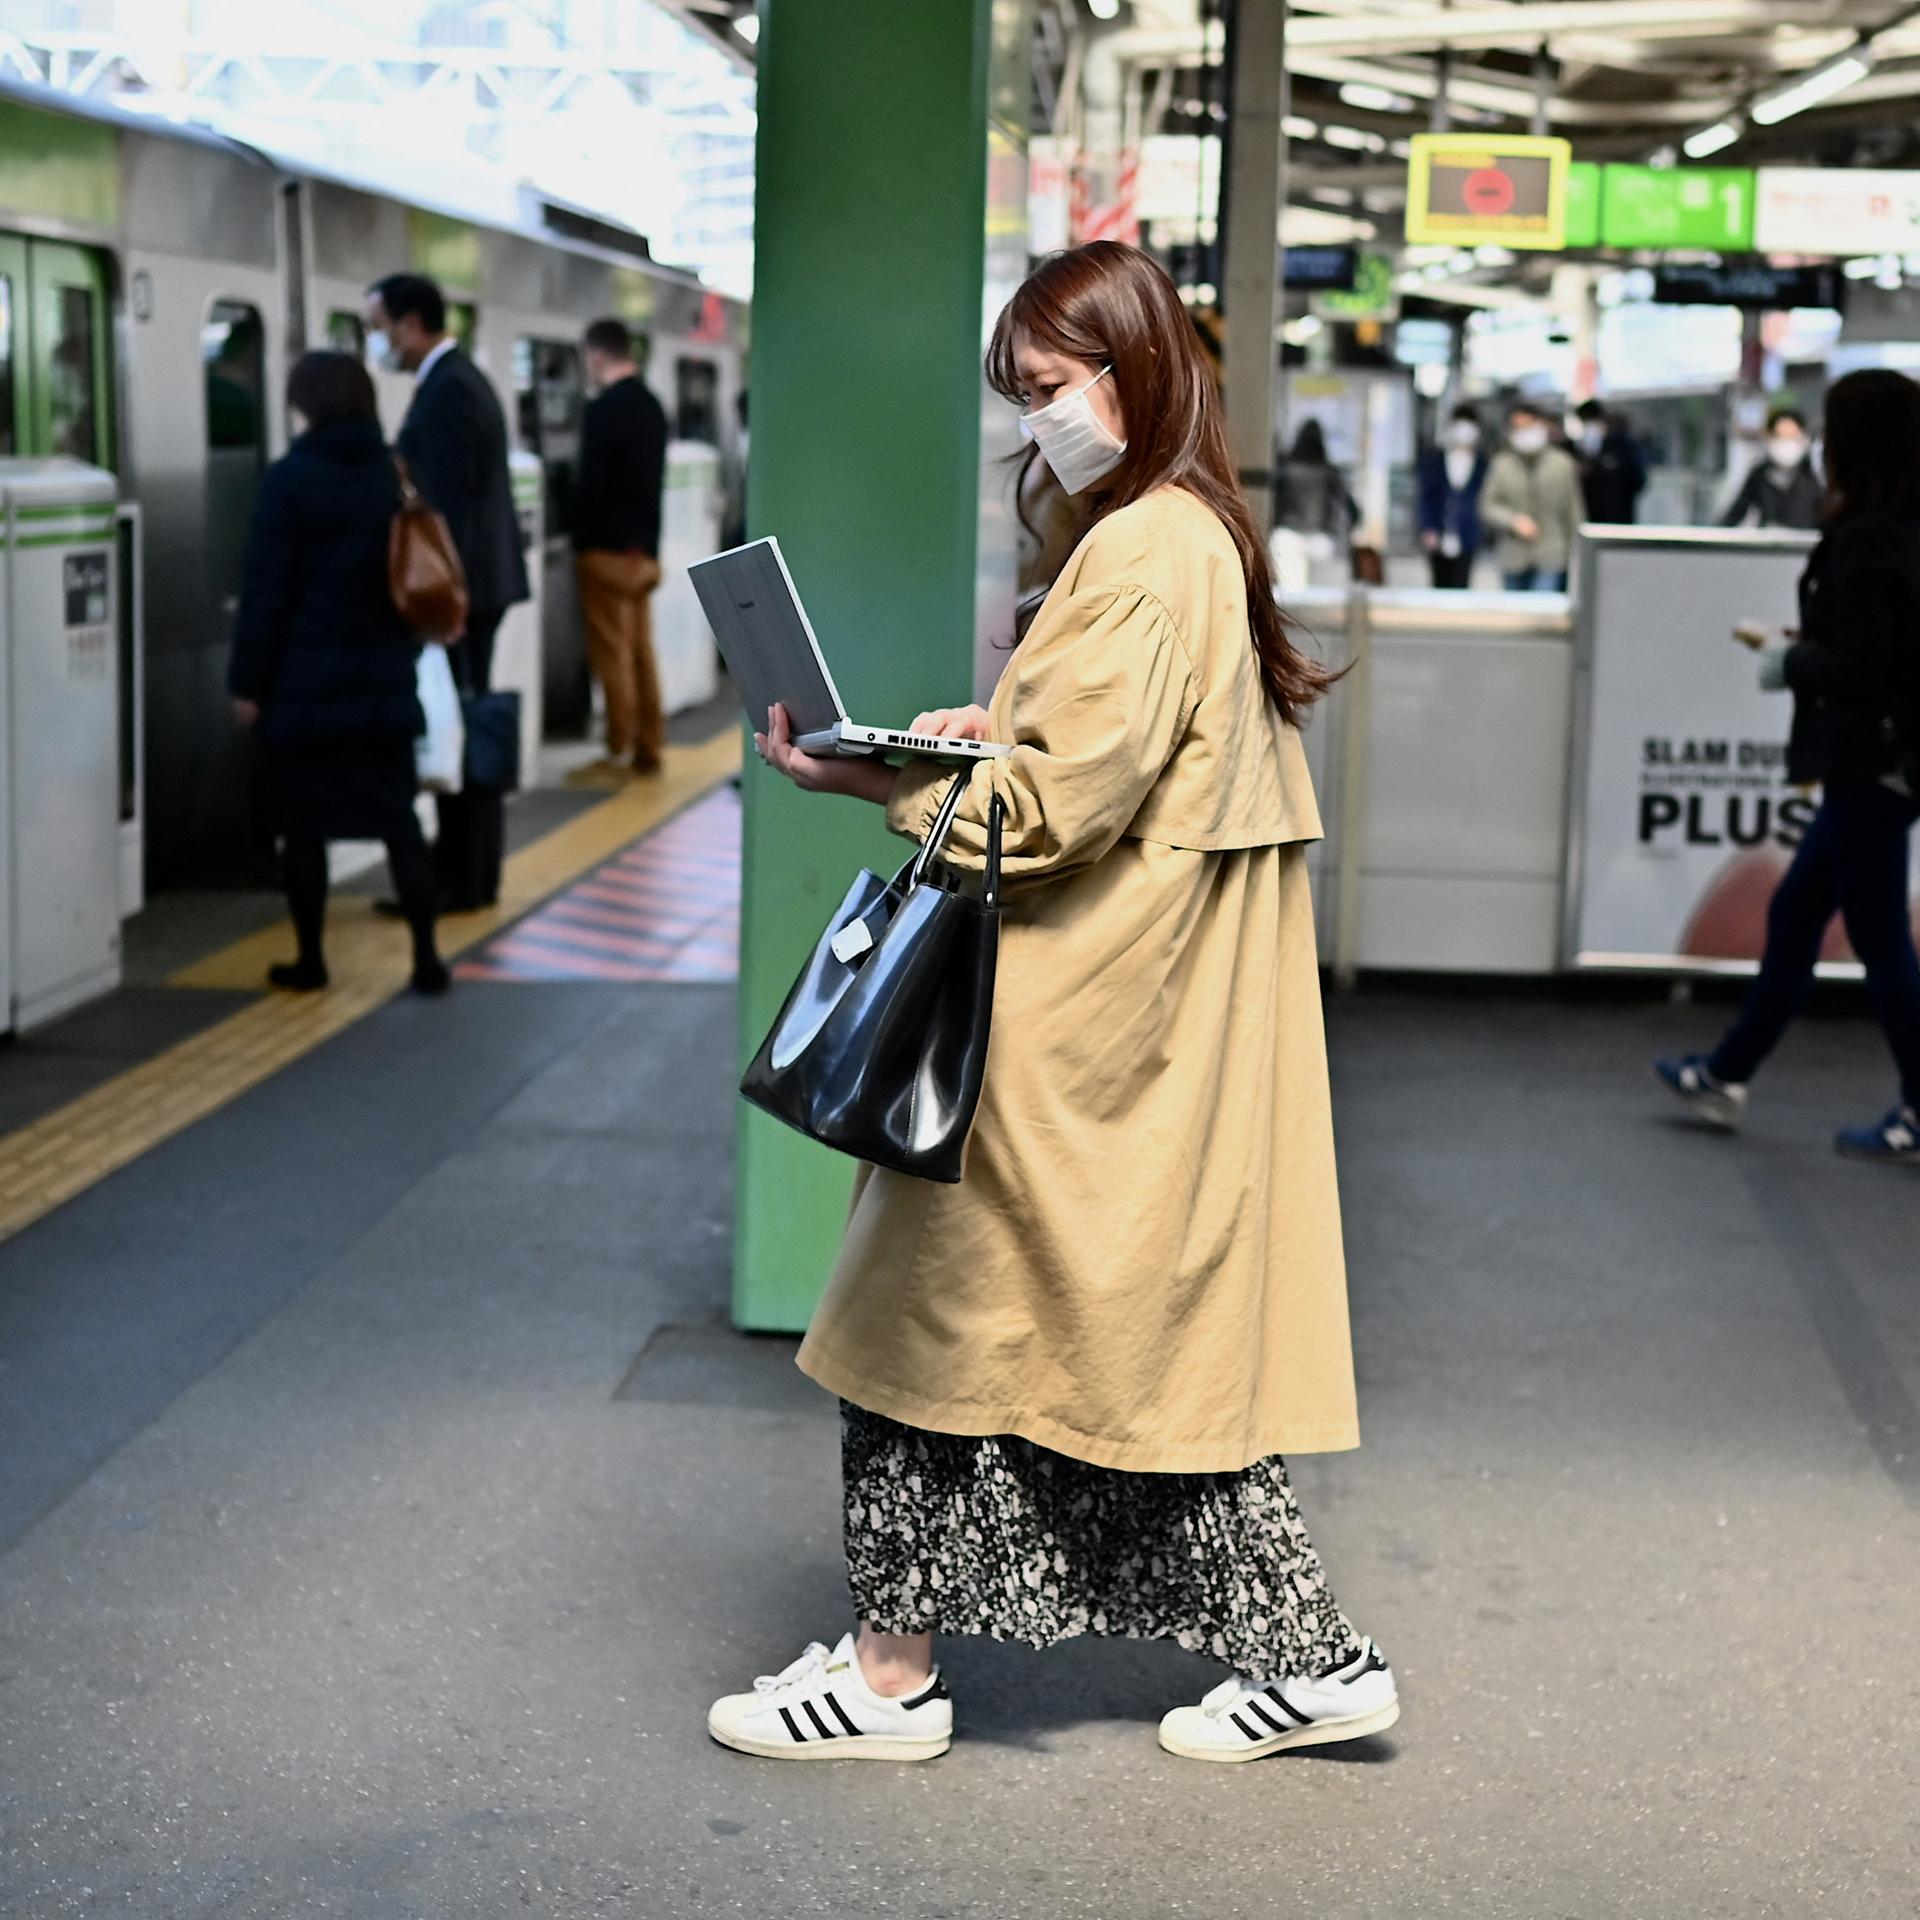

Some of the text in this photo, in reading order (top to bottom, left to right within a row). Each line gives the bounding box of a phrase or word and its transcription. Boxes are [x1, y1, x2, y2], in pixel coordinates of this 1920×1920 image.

[1719, 181, 1742, 236] 1
[1644, 737, 1729, 765] SLAM
[1639, 794, 1817, 848] PLUS
